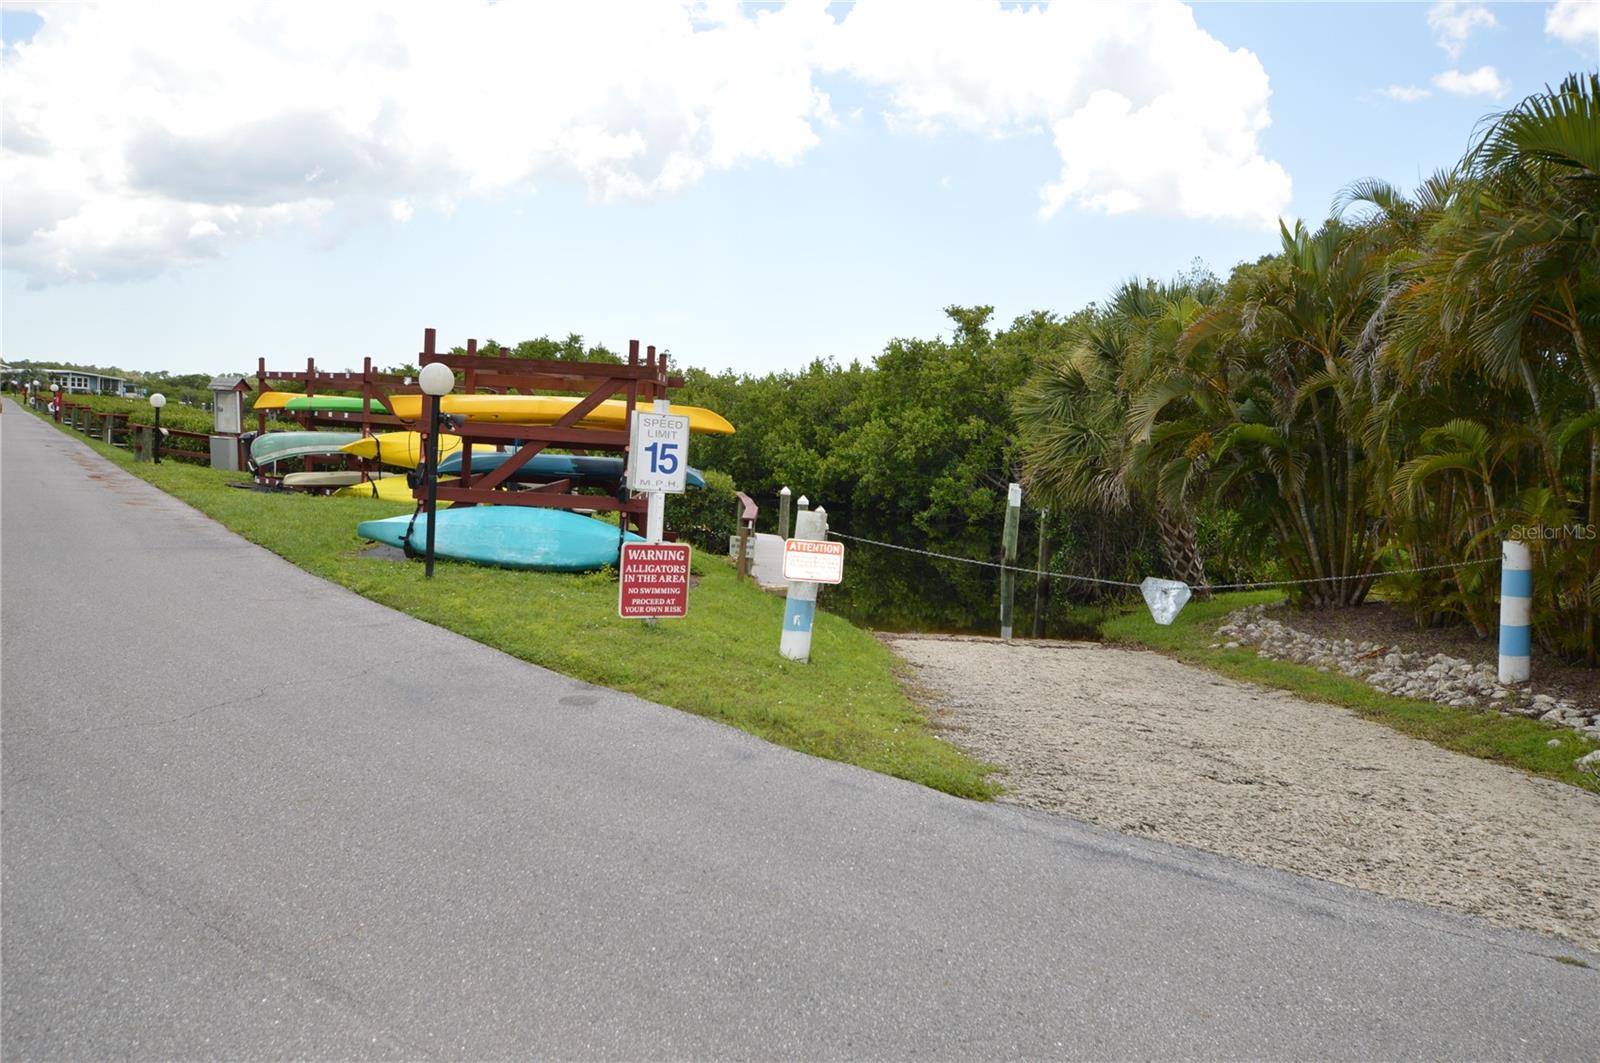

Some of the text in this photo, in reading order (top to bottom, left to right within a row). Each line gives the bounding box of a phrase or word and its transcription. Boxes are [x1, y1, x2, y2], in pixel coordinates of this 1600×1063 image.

[643, 418, 683, 430] SPEED
[647, 430, 678, 439] LIMIT
[644, 442, 678, 474] 15
[789, 542, 840, 554] ATTENTION
[628, 549, 685, 561] WARNING
[625, 564, 686, 574] ALLIGATORS
[624, 574, 685, 583] IN THE AREA
